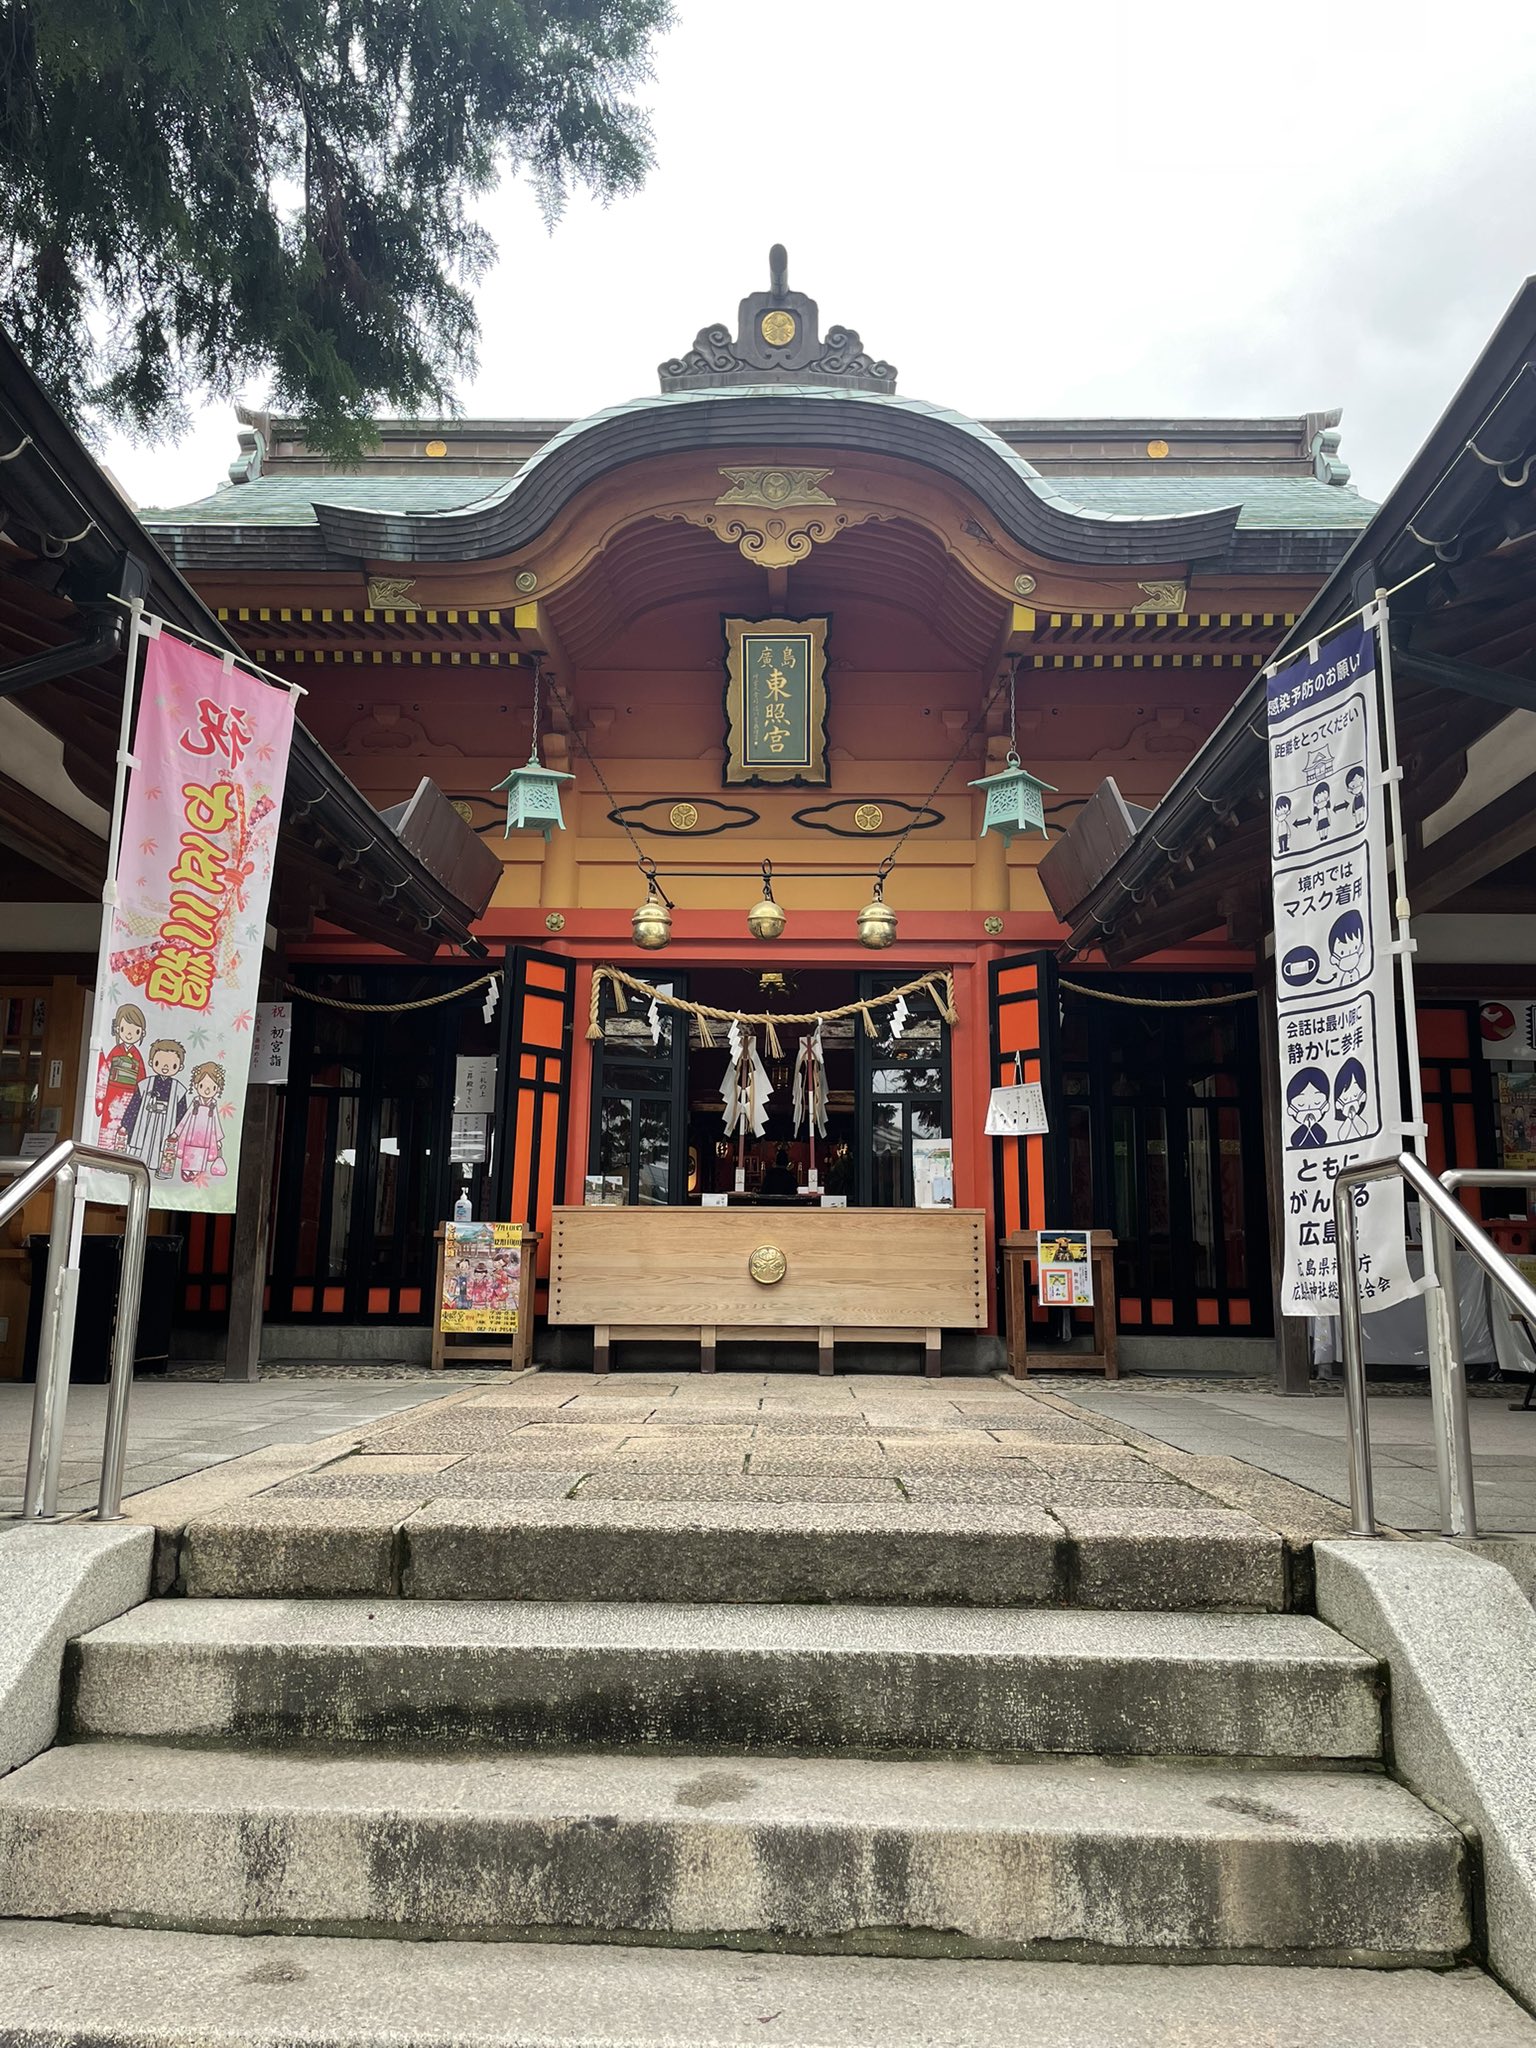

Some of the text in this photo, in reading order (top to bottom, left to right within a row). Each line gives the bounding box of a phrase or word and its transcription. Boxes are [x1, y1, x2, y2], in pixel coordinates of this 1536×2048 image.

[1267, 653, 1361, 717] 感染予防のお願い
[763, 668, 792, 754] 東照宮
[1274, 708, 1359, 759] 距離をとってください
[1283, 877, 1362, 918] マスク着用
[1298, 862, 1353, 893] 境内では
[269, 1026, 285, 1067] 初宮詣
[1290, 1183, 1370, 1215] がんる
[1299, 1216, 1360, 1246] 広島
